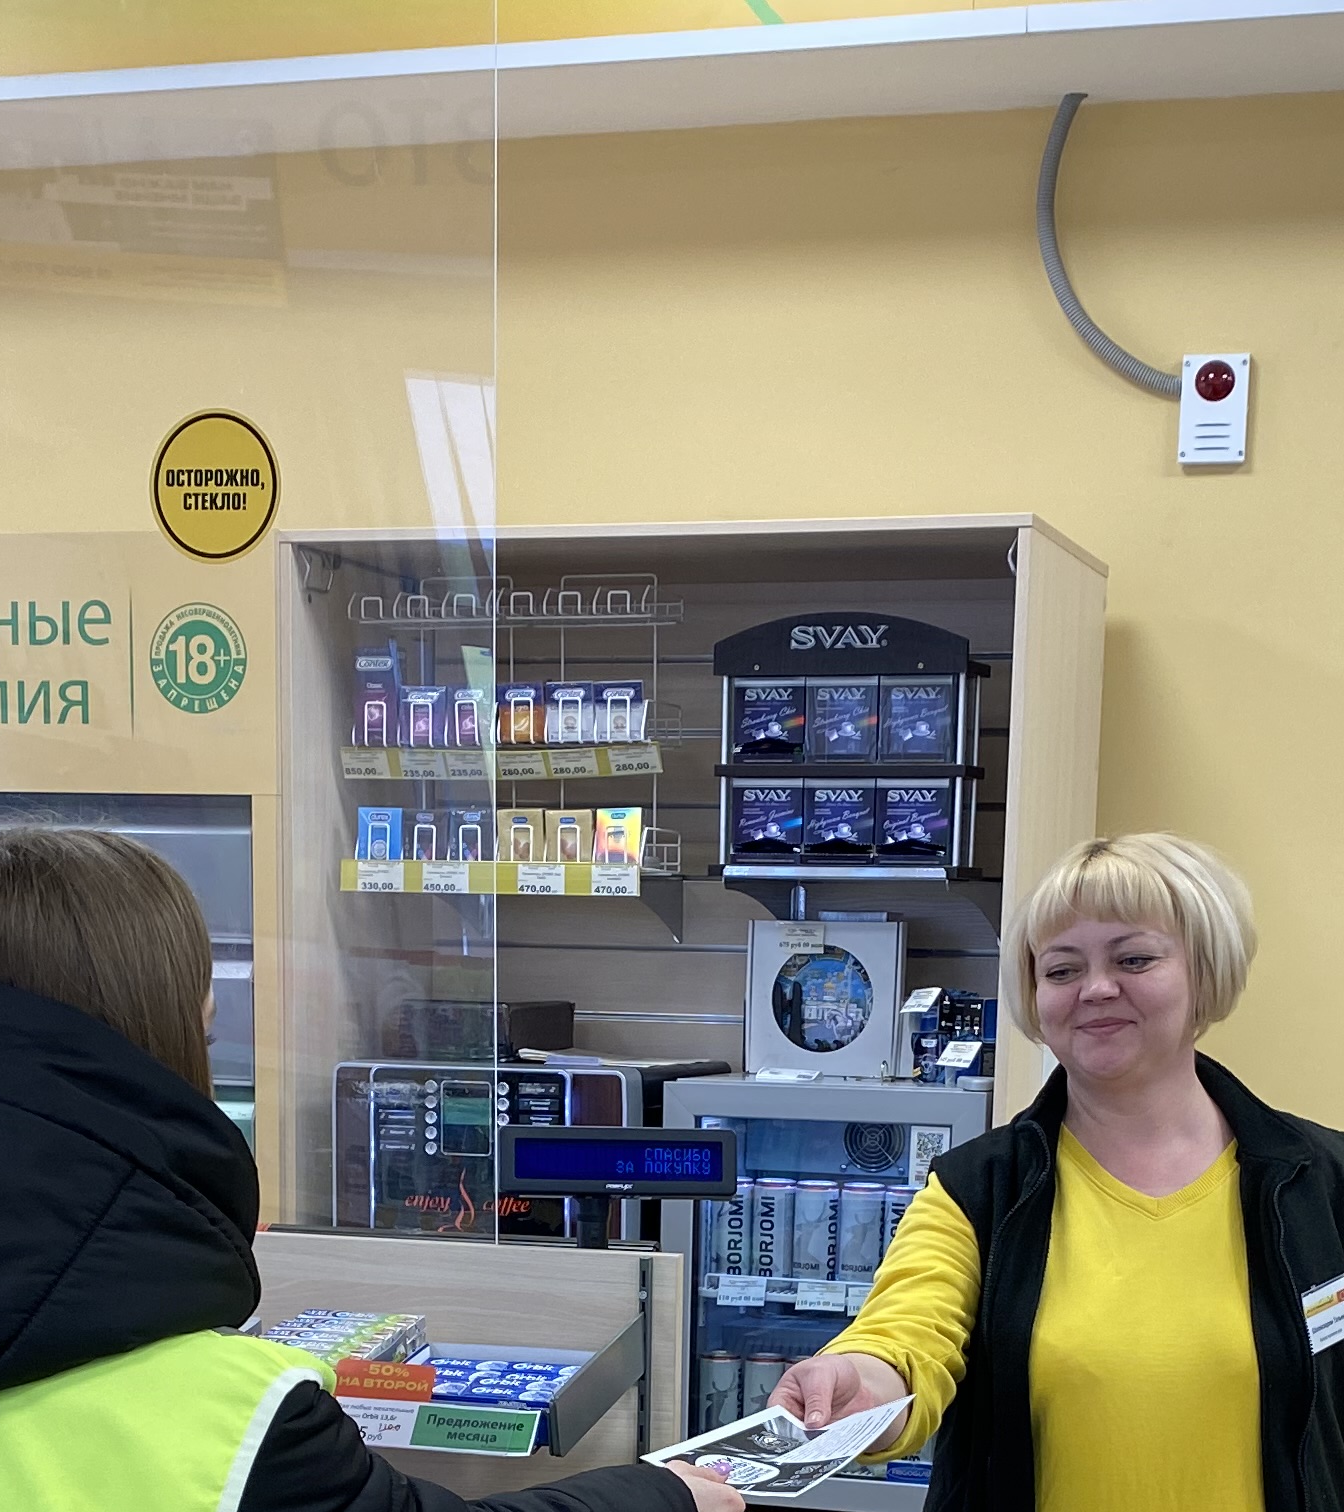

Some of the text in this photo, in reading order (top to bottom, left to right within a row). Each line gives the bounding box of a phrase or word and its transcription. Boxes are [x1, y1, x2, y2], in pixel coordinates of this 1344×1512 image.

[165, 469, 265, 490] ОСТОРОЖНО,
[182, 491, 247, 512] СТЕКЛО!
[790, 625, 888, 650] SVAY
[169, 634, 230, 685] 18+
[152, 664, 244, 711] ЗАПРЕЩЕНА
[745, 688, 792, 700] SVAY
[615, 762, 649, 772] 280,00
[887, 790, 936, 802] SVAY
[361, 882, 394, 891] 330,00
[518, 884, 551, 893] 470,00
[645, 1149, 711, 1160] СПАСИБО
[616, 1161, 711, 1175] ЗА ПОКУПКУ
[405, 1195, 530, 1216] enjoy coffee
[759, 1196, 775, 1278] BORJOMI
[364, 1364, 410, 1378] -50%
[513, 1363, 554, 1372] Orbit
[338, 1376, 429, 1392] НА ВТОРОЙ
[427, 1413, 525, 1432] Предложение
[446, 1430, 497, 1443] месяца
